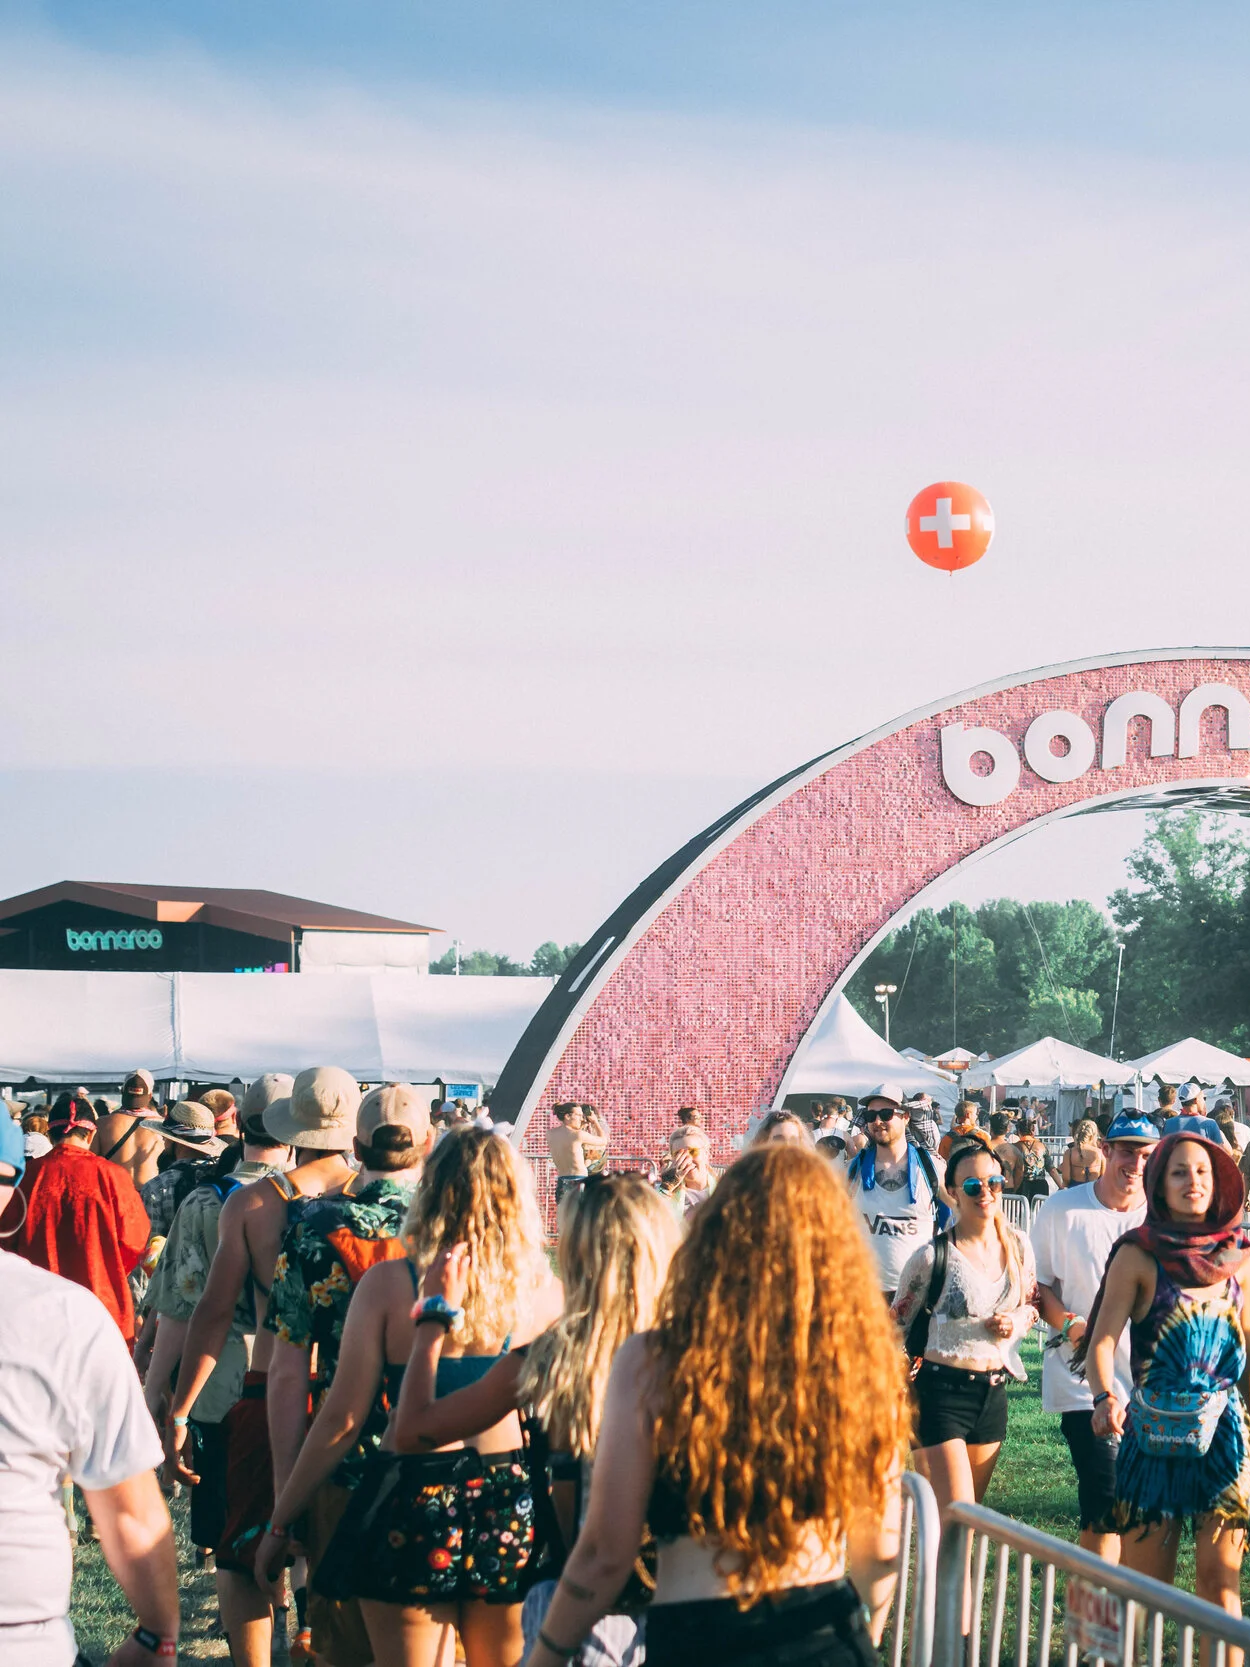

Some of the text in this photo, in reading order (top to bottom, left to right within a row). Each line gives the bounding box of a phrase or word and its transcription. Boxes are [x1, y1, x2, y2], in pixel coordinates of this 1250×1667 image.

[66, 928, 163, 951] bonnaroo
[1113, 1120, 1154, 1135] KAVU
[863, 1213, 918, 1236] VANS
